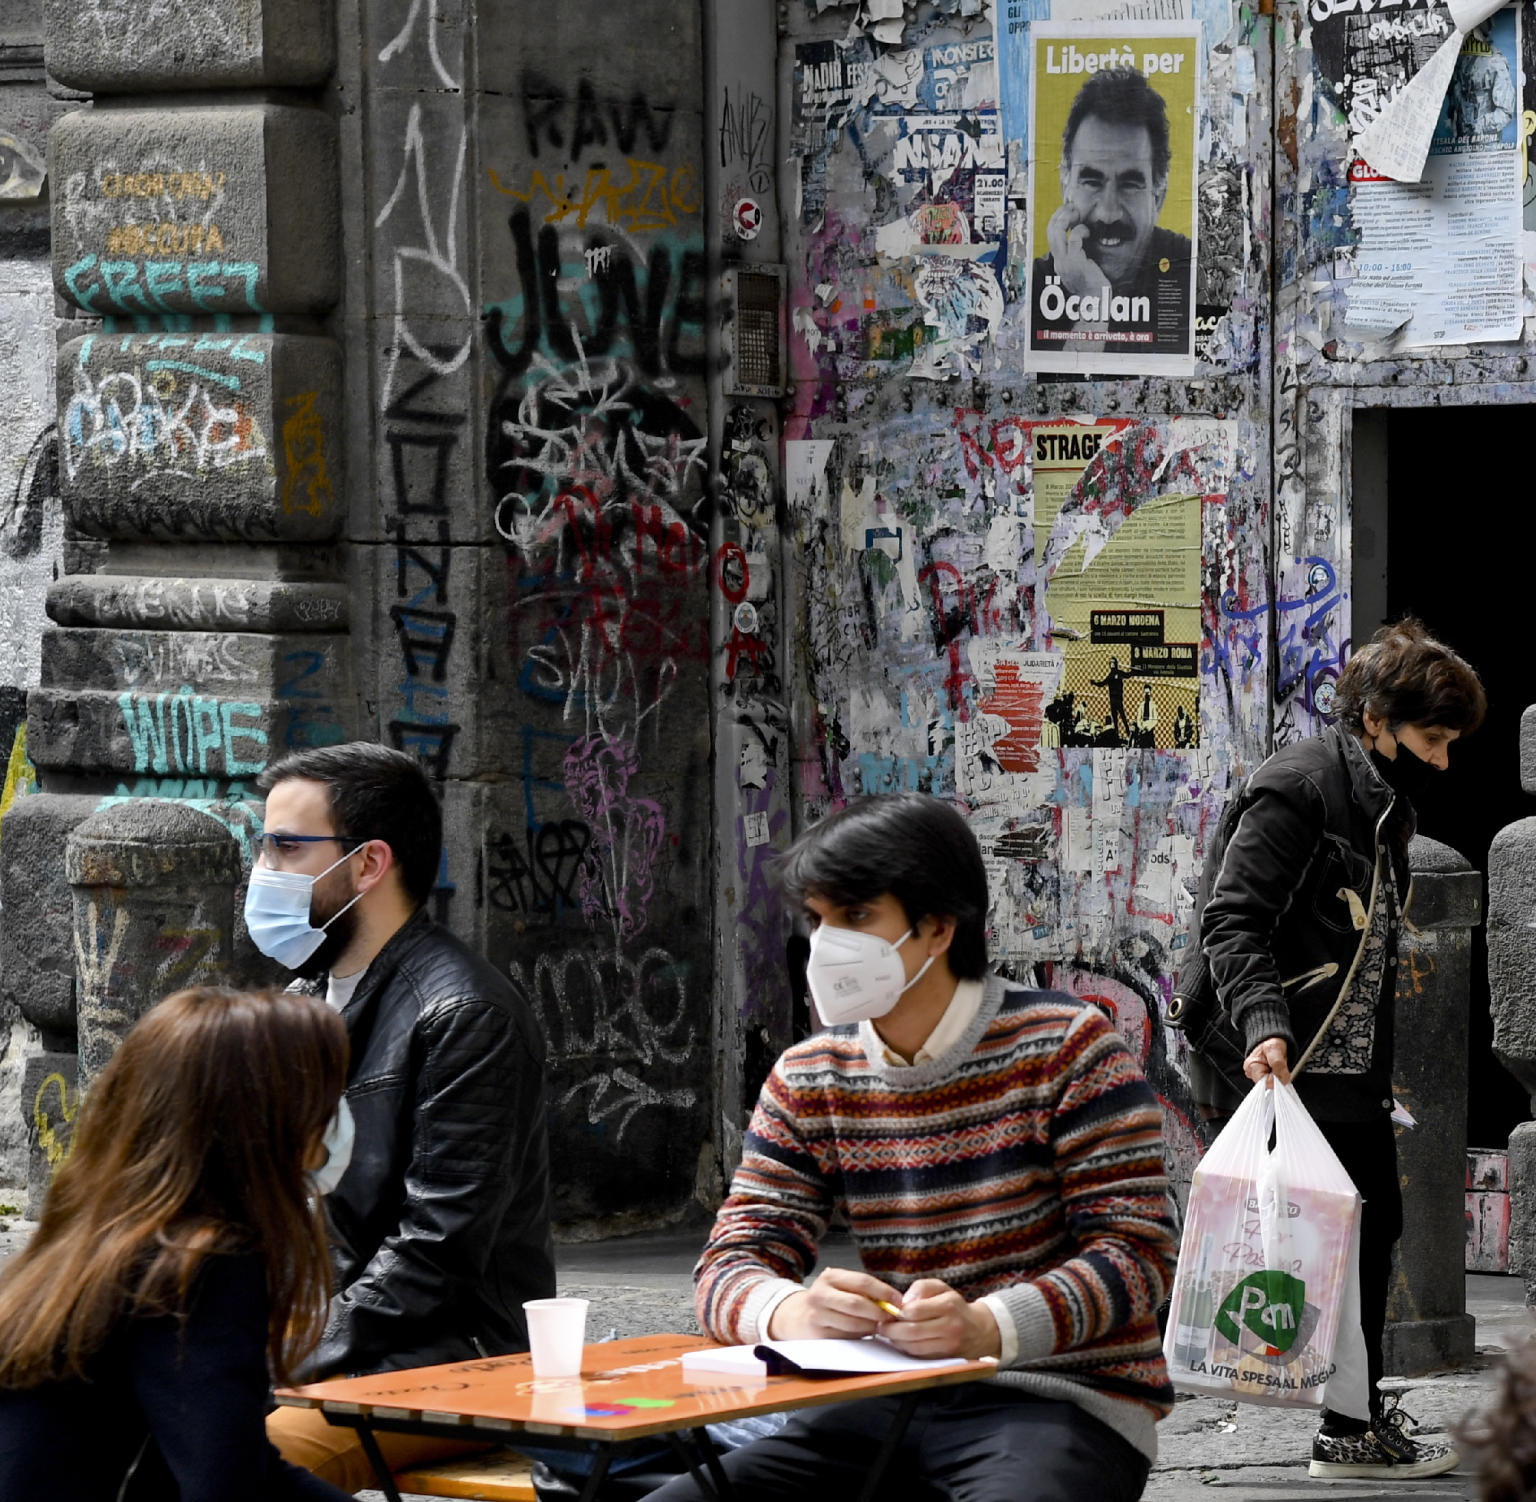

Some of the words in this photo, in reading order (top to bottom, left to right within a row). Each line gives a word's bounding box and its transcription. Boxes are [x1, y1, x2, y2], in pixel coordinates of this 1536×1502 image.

[1046, 45, 1136, 75] Libertà
[1143, 50, 1185, 78] per
[1040, 276, 1151, 323] Öcalan
[1050, 331, 1086, 340] momento
[1136, 333, 1150, 342] ora
[1100, 615, 1127, 626] MARZO
[1129, 615, 1161, 626] MODENA
[1142, 647, 1169, 659] MARZO
[1171, 648, 1193, 659] ROMA
[1189, 1360, 1207, 1375] LA
[1211, 1364, 1240, 1381] VITA
[1241, 1370, 1281, 1387] SPESA
[1281, 1375, 1298, 1390] AL
